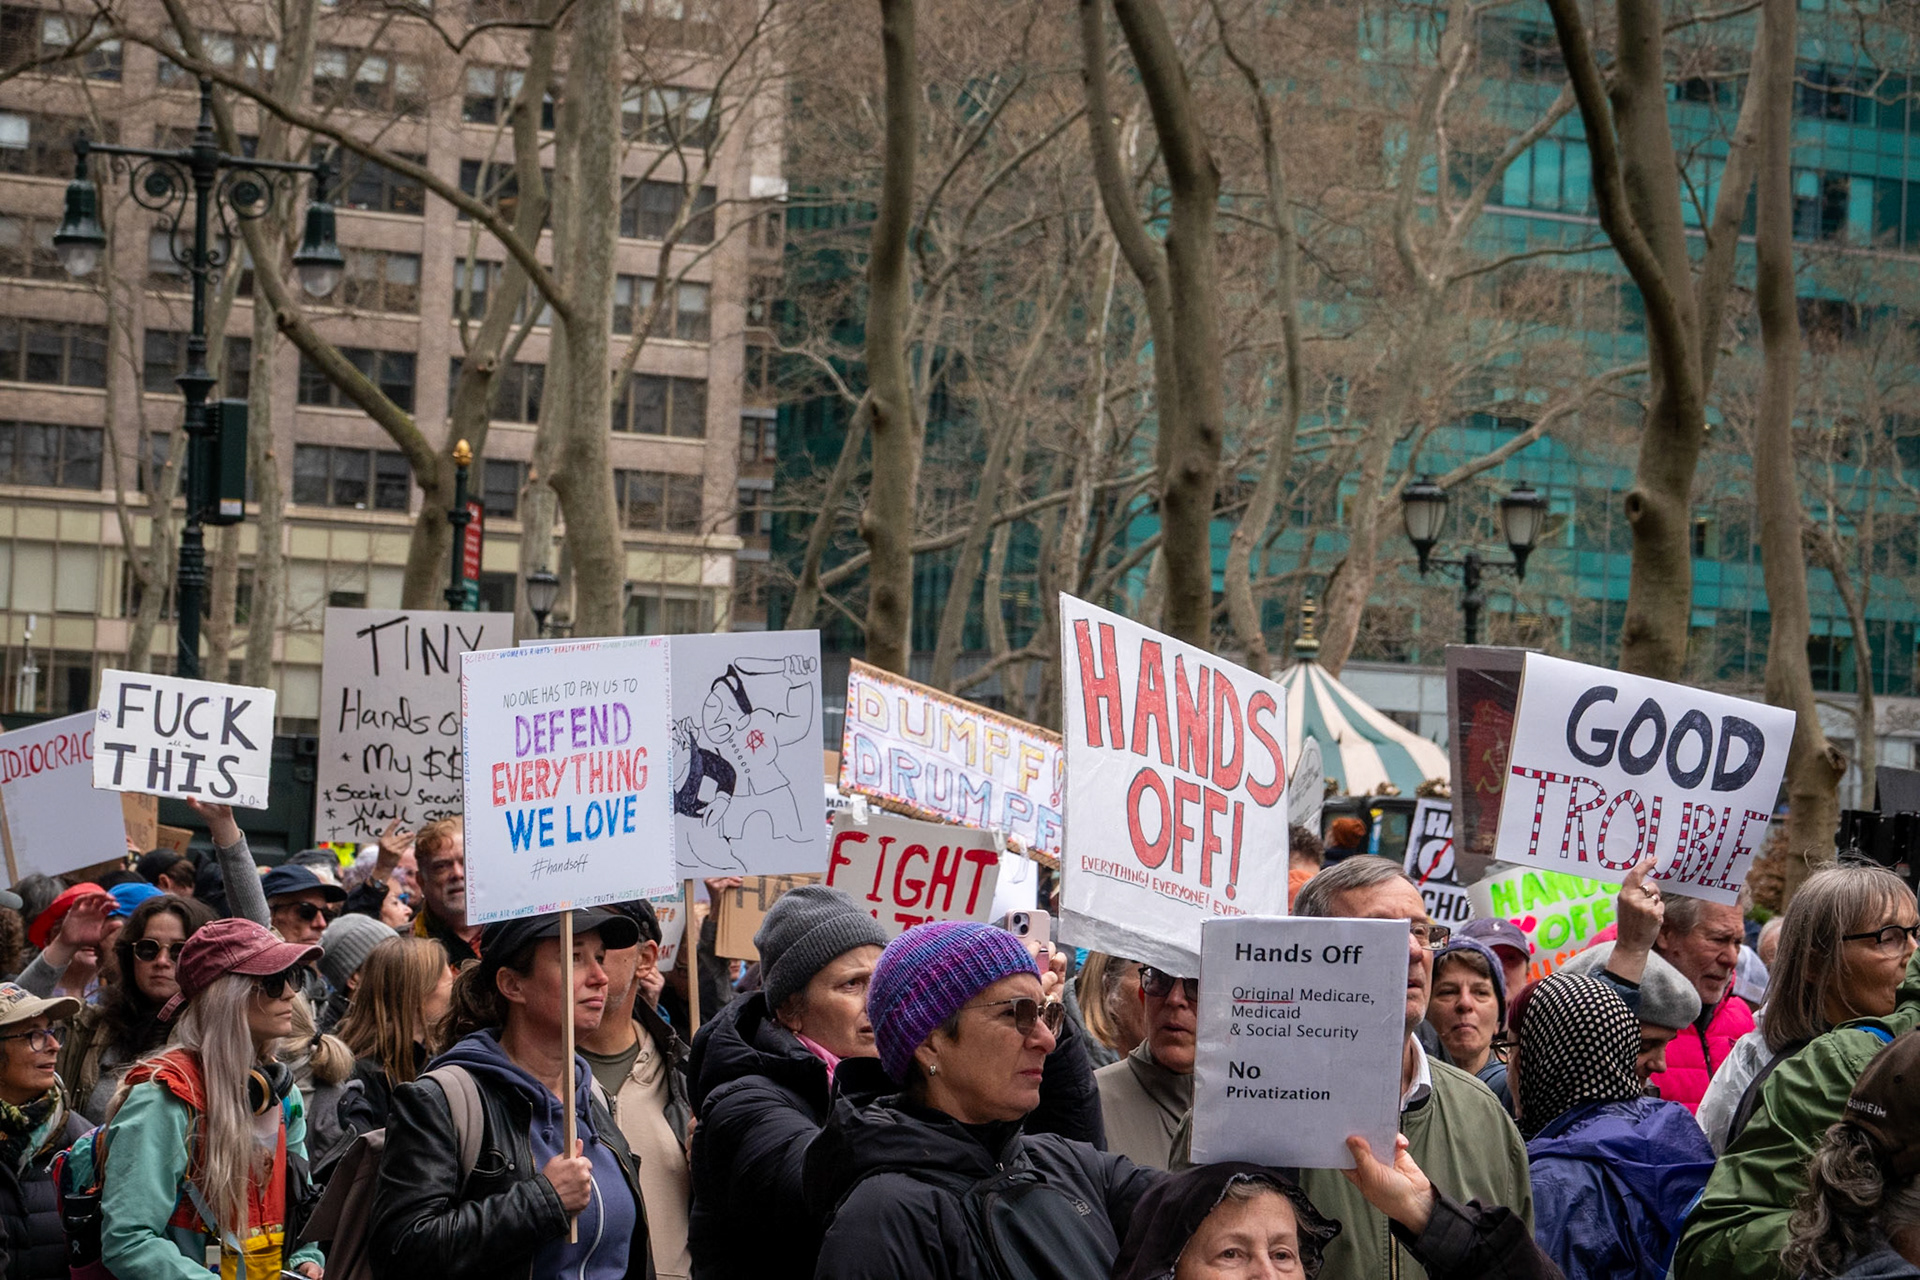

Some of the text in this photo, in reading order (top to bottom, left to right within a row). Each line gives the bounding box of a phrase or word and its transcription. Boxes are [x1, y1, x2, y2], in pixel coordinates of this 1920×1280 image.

[356, 615, 485, 683] TINY
[465, 652, 496, 664] SCIENCE
[529, 647, 551, 656] RIGHTS
[553, 644, 575, 655] HEALTH
[117, 683, 258, 751] FUCK
[339, 687, 431, 735] Hands
[503, 678, 638, 708] NO ONE HAS TO PAY US TO
[1073, 618, 1286, 808] HANDS
[0, 728, 95, 784] IDIOCRAC
[515, 702, 632, 758] DEFEND
[1566, 685, 1765, 792] GOOD
[104, 742, 240, 799] THIS
[335, 784, 462, 805] Social Securi
[363, 743, 413, 796] My
[461, 674, 477, 917] LIBRARIES MUSEUMS EDUCATION EQUITY
[492, 746, 648, 808] EVERYTHING
[354, 802, 414, 825] Wall
[505, 794, 638, 854] WE LOVE
[1126, 766, 1245, 900] OFF!
[1511, 765, 1769, 892] TROUBLE
[530, 854, 590, 880] #handsoff
[826, 831, 999, 915] FIGHT
[1081, 855, 1149, 887] EVERYTHING!
[1152, 877, 1210, 908] EVERYONE!
[477, 911, 498, 922] CLEAN
[500, 909, 511, 918] AIR
[538, 902, 557, 912] PEACE
[593, 892, 615, 903] TRUTH
[617, 887, 645, 899] JUSTICE
[646, 884, 675, 897] FREEDOM
[1537, 897, 1616, 950] OFF
[1235, 942, 1364, 965] Hands Off
[1231, 1005, 1301, 1020] Medicaid
[1232, 986, 1375, 1006] Original Medicare,
[1230, 1023, 1359, 1041] & Social Security
[1226, 1085, 1331, 1101] Privatization
[1229, 1061, 1261, 1080] No
